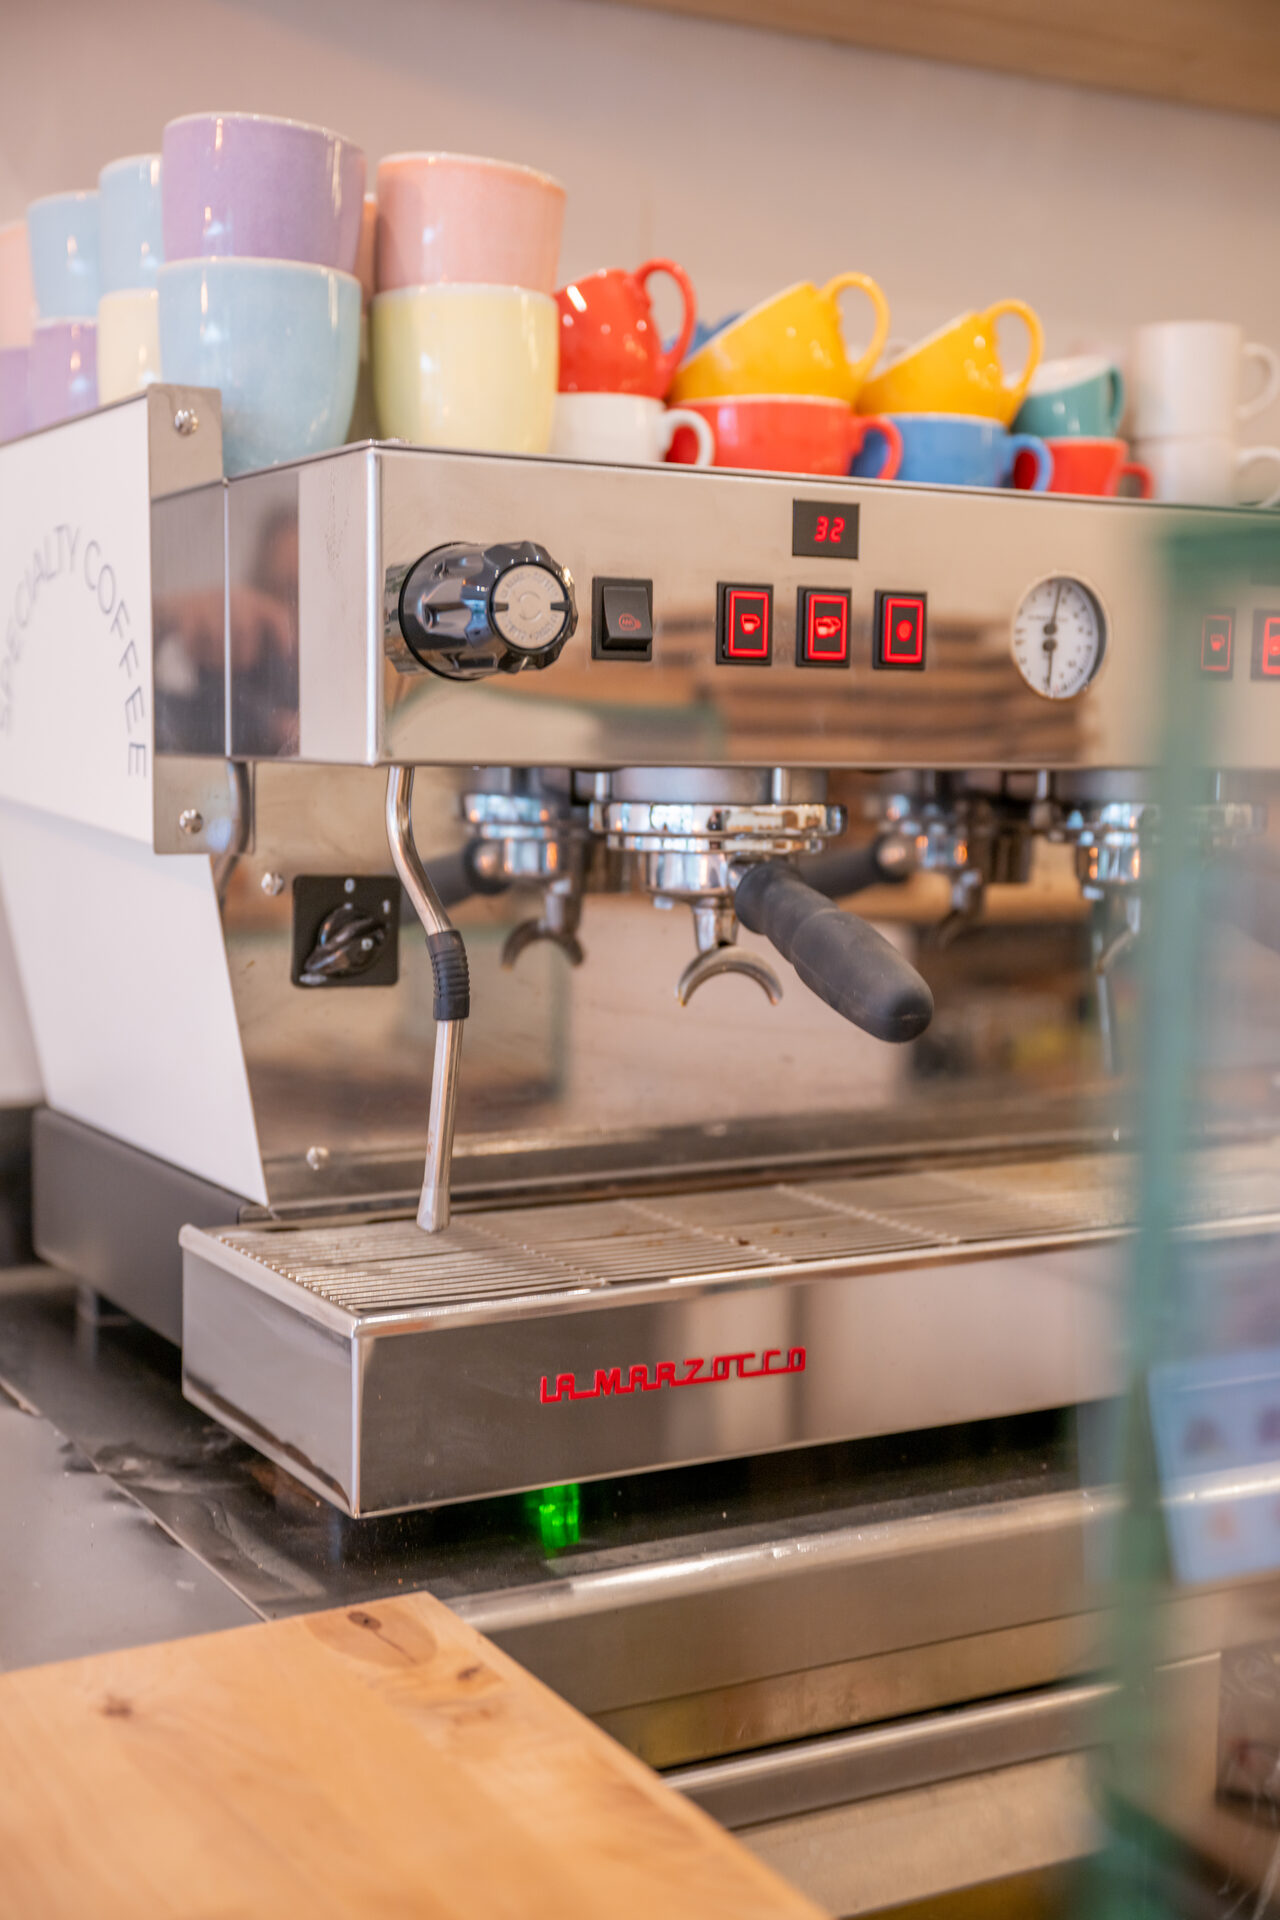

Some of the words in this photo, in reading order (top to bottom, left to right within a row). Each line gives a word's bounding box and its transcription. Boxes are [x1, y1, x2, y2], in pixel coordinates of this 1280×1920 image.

[814, 515, 845, 543] 32
[84, 539, 147, 778] COFFEE
[540, 1373, 577, 1404] LA
[594, 1347, 806, 1396] MARZOCCO
